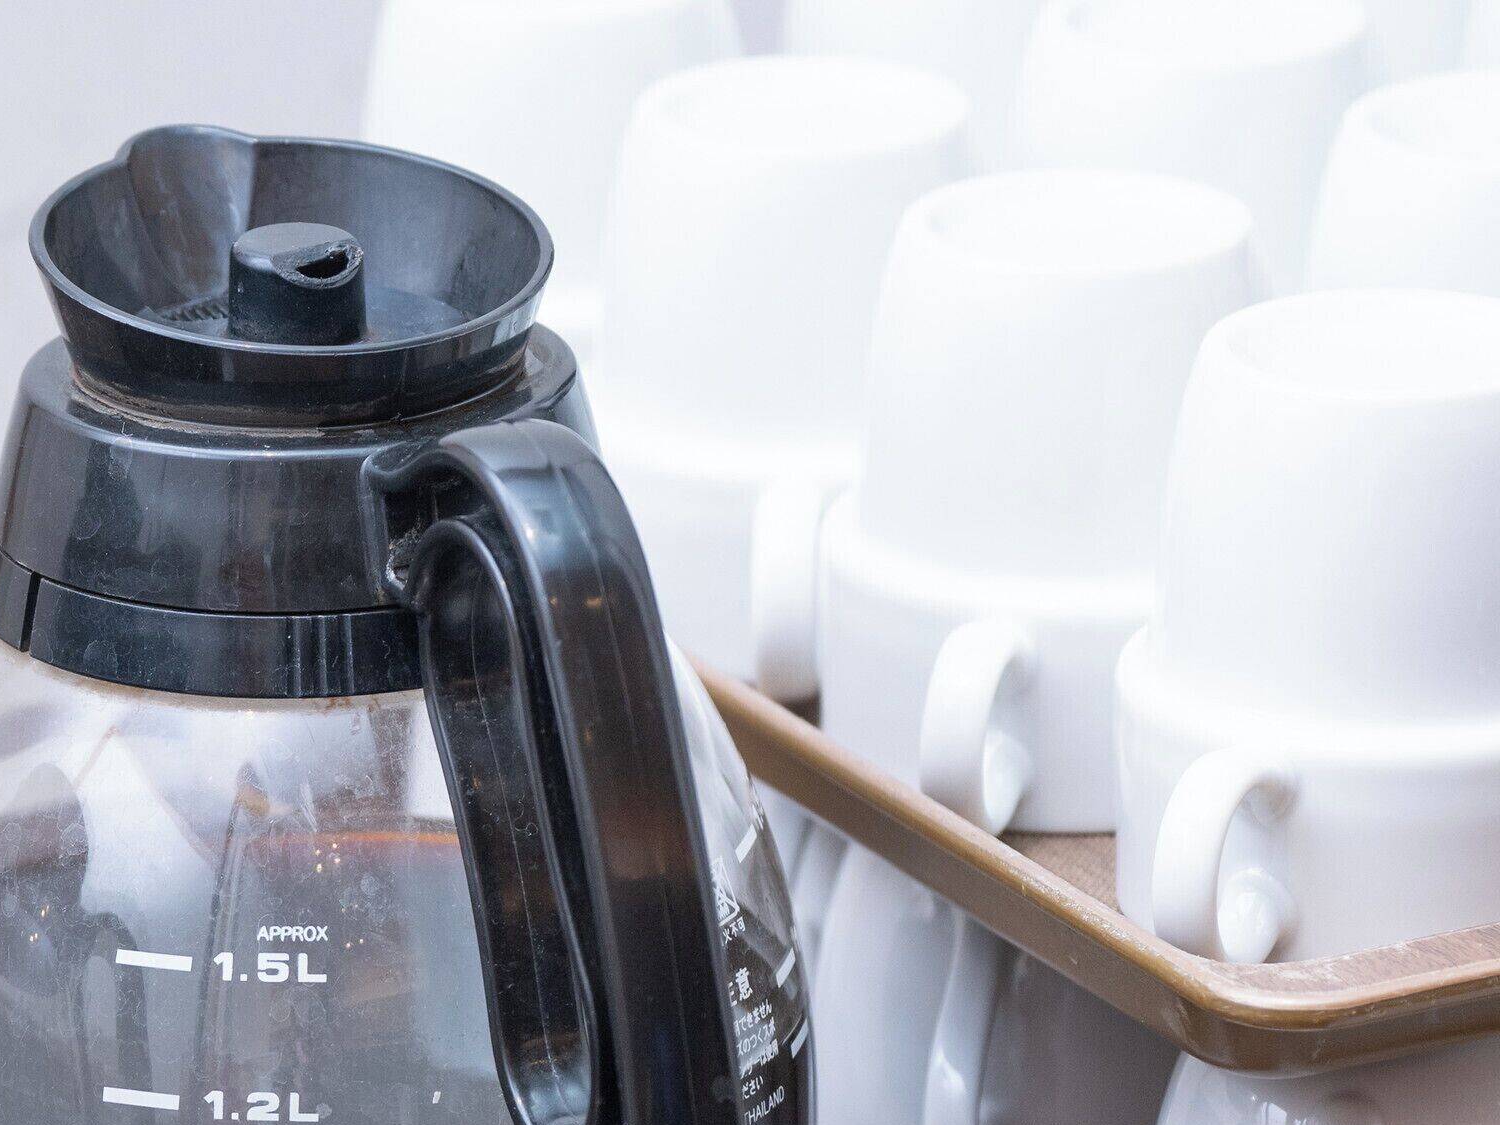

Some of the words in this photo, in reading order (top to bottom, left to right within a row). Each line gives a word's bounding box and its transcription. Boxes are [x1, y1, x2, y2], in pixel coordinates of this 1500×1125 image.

[256, 925, 329, 942] APPROX
[212, 951, 328, 983] 1.5L
[203, 1090, 320, 1123] 1.2L
